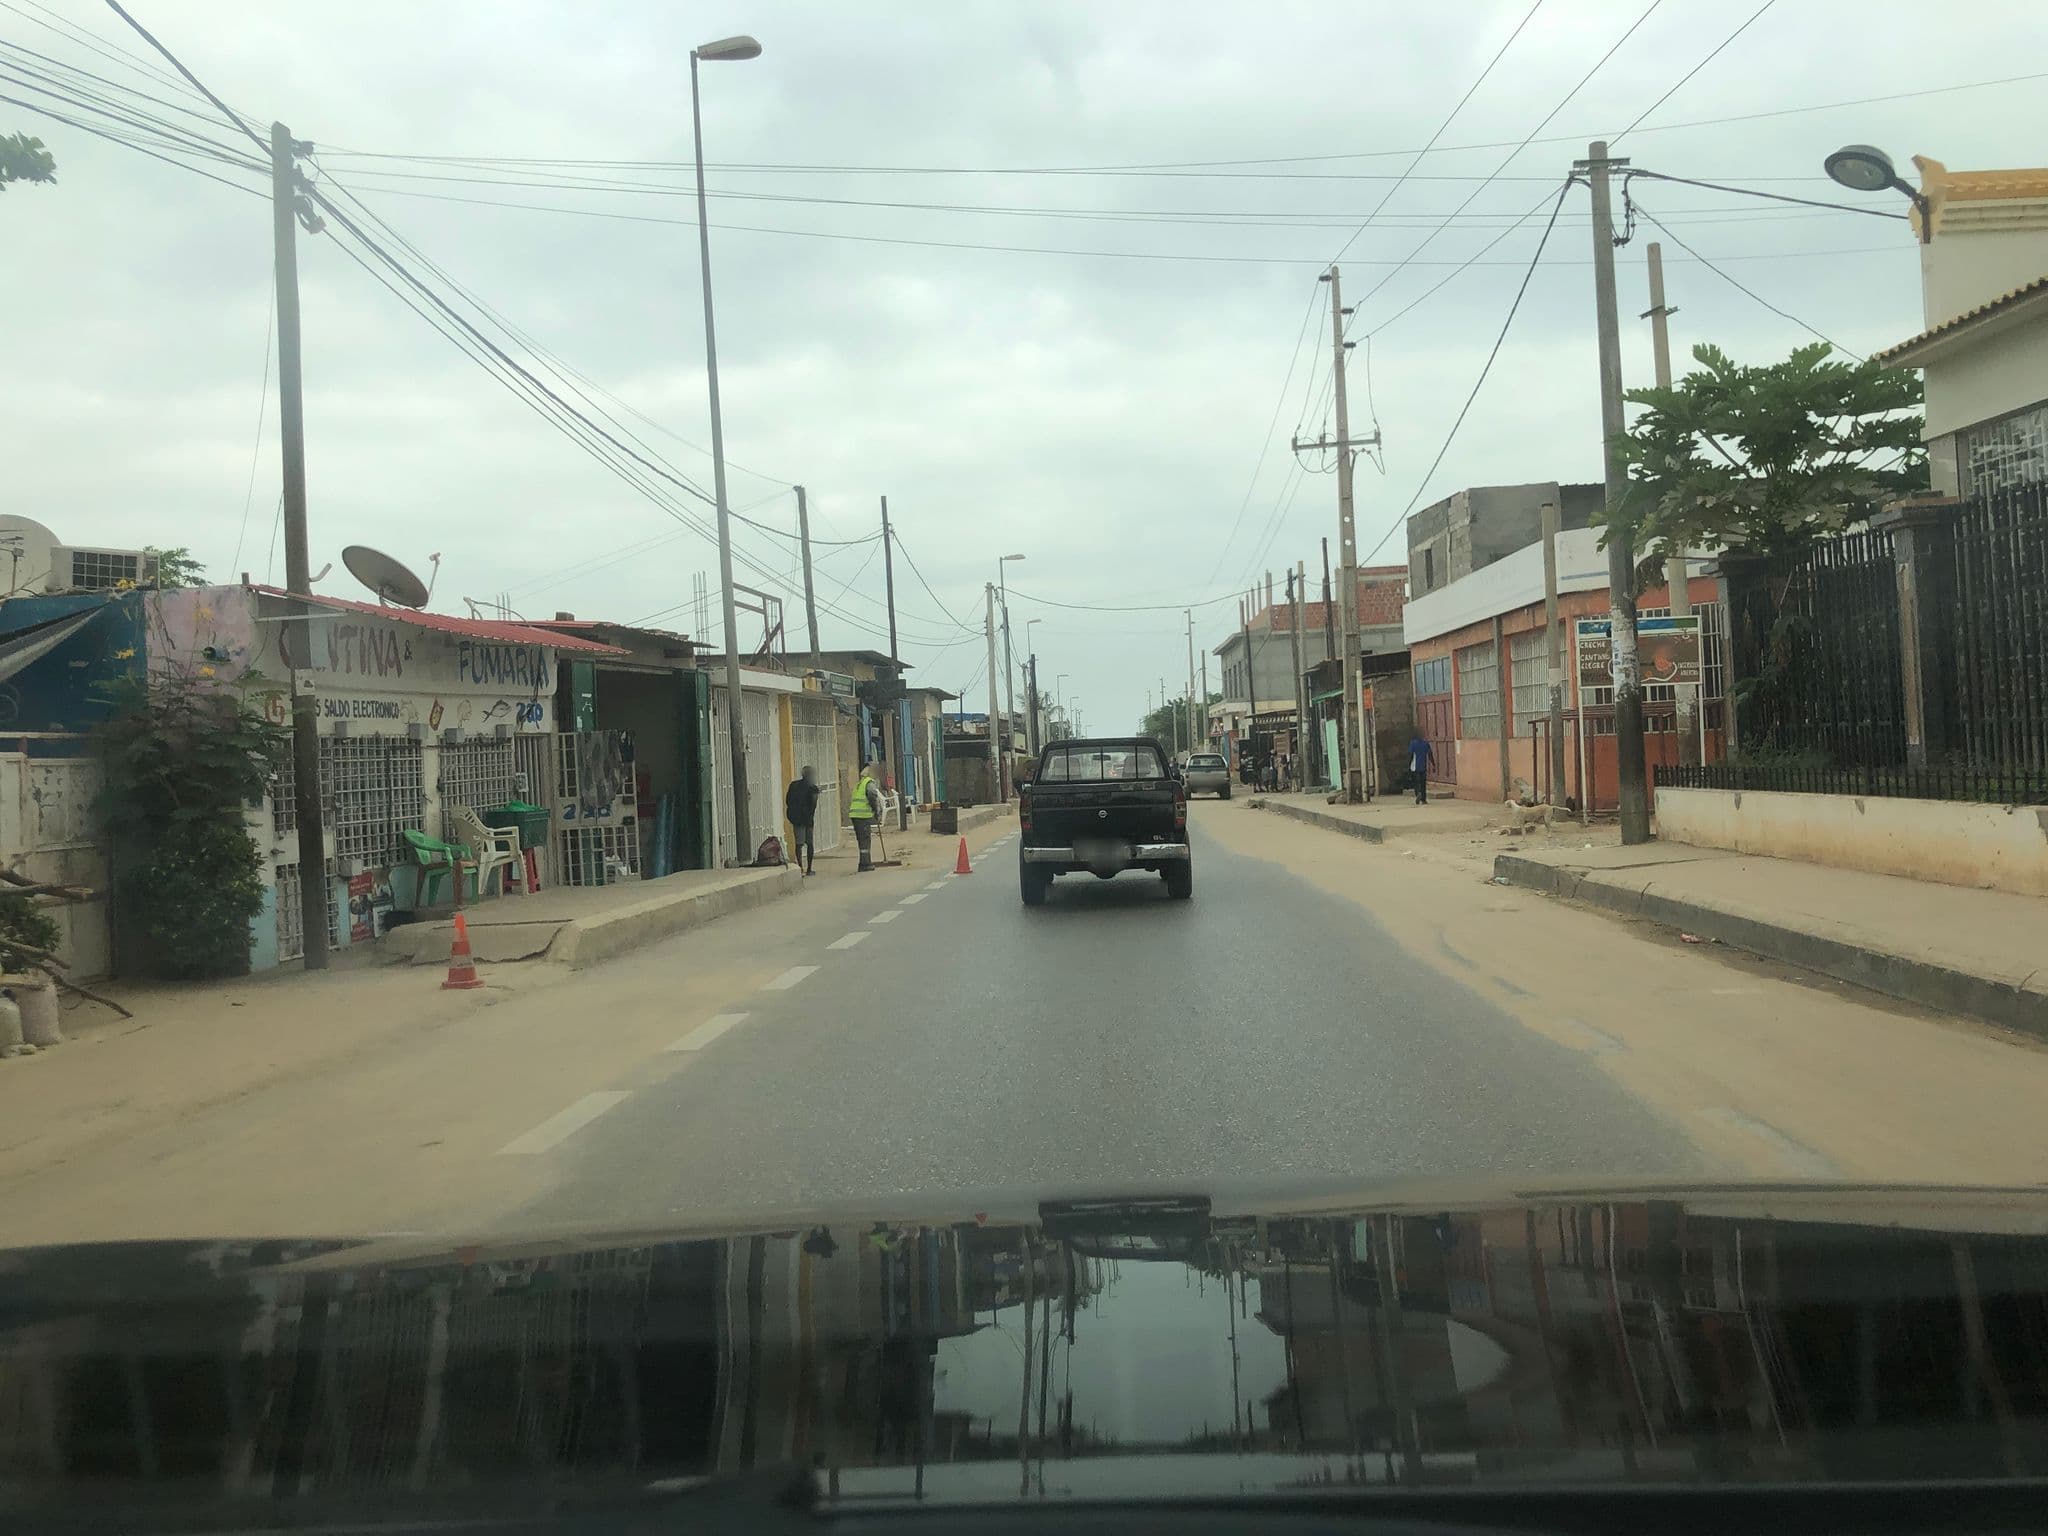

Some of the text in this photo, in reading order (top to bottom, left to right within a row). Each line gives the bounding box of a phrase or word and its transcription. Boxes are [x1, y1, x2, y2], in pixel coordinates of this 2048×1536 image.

[404, 639, 413, 661] &
[459, 640, 549, 690] FUMARIA
[324, 698, 350, 718] SALDO
[352, 700, 400, 719] ELECTRONICO
